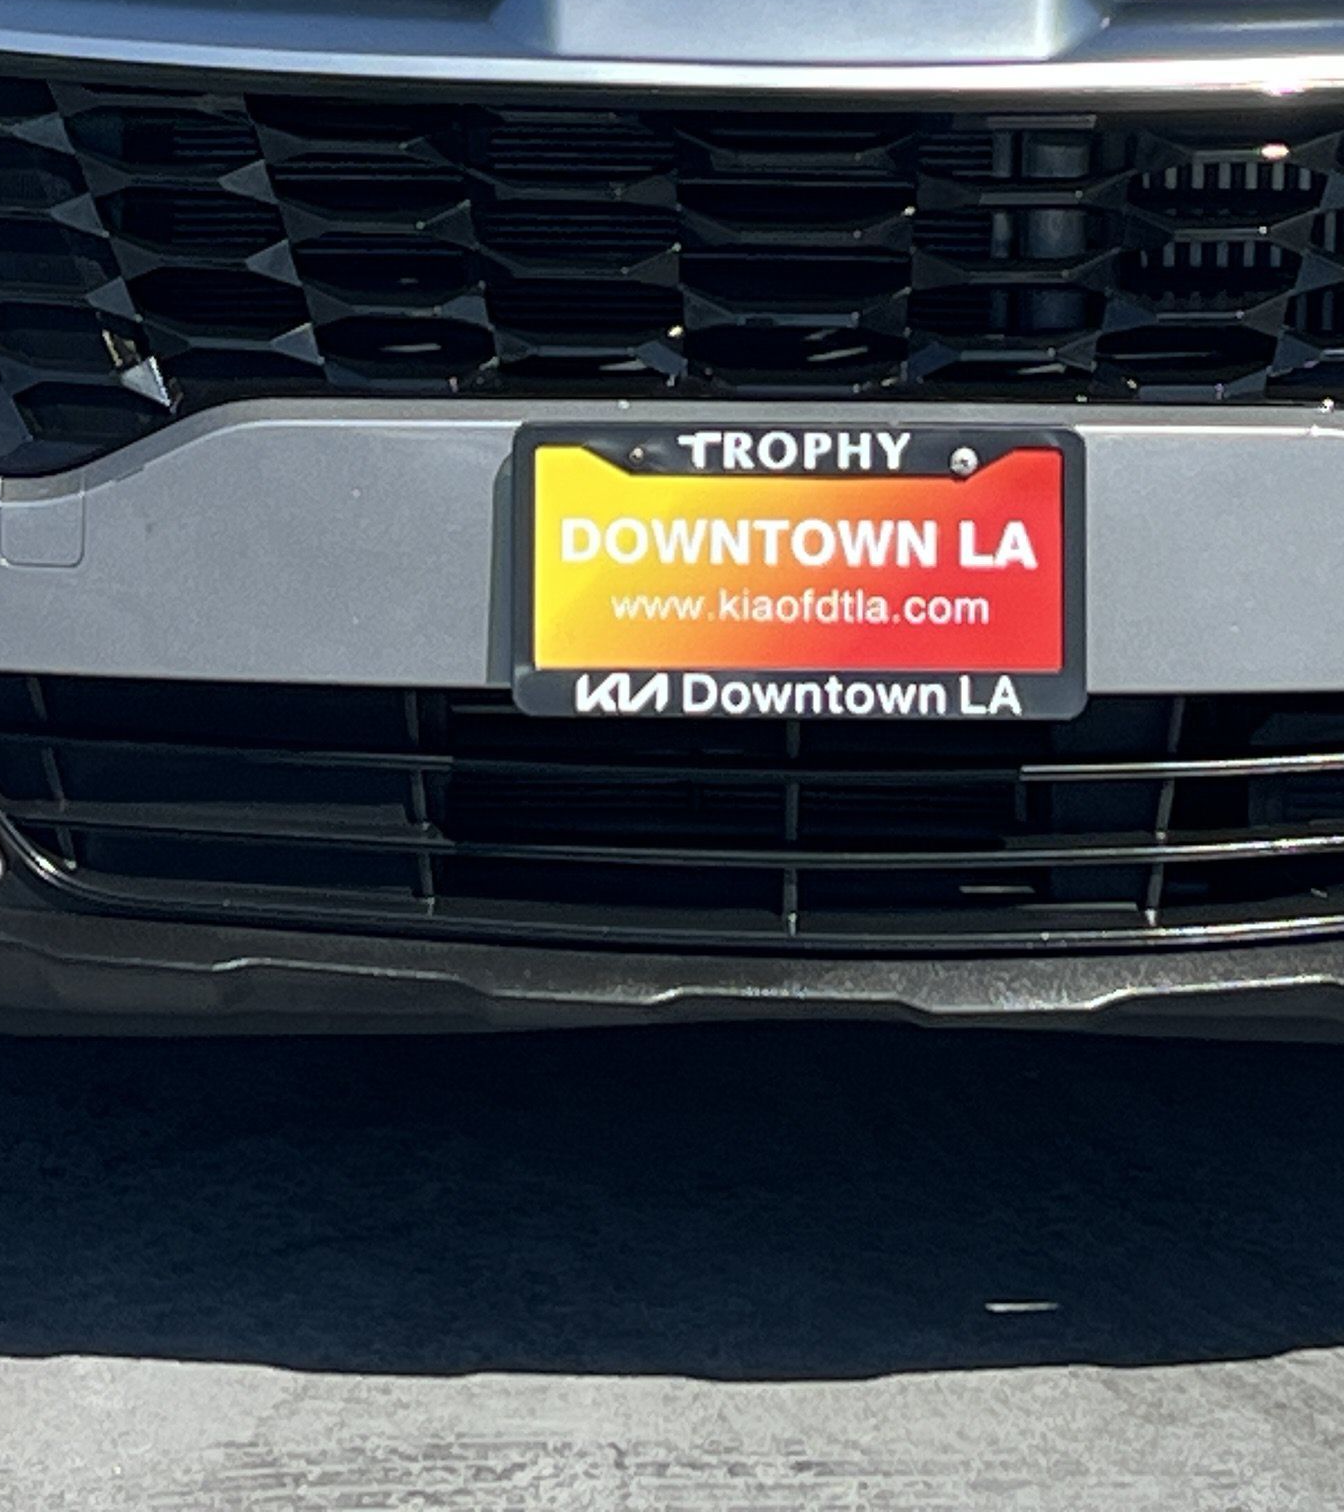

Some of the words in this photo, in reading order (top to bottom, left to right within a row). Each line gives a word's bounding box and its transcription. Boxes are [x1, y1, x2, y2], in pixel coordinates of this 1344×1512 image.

[677, 431, 911, 471] TROPHY
[560, 518, 938, 566] DOWNTOWN
[959, 520, 1037, 569] LA
[610, 589, 990, 625] www.kiaofdtla.com
[575, 673, 668, 713] KIA
[682, 674, 947, 715] Downtown
[959, 676, 1022, 716] LA
